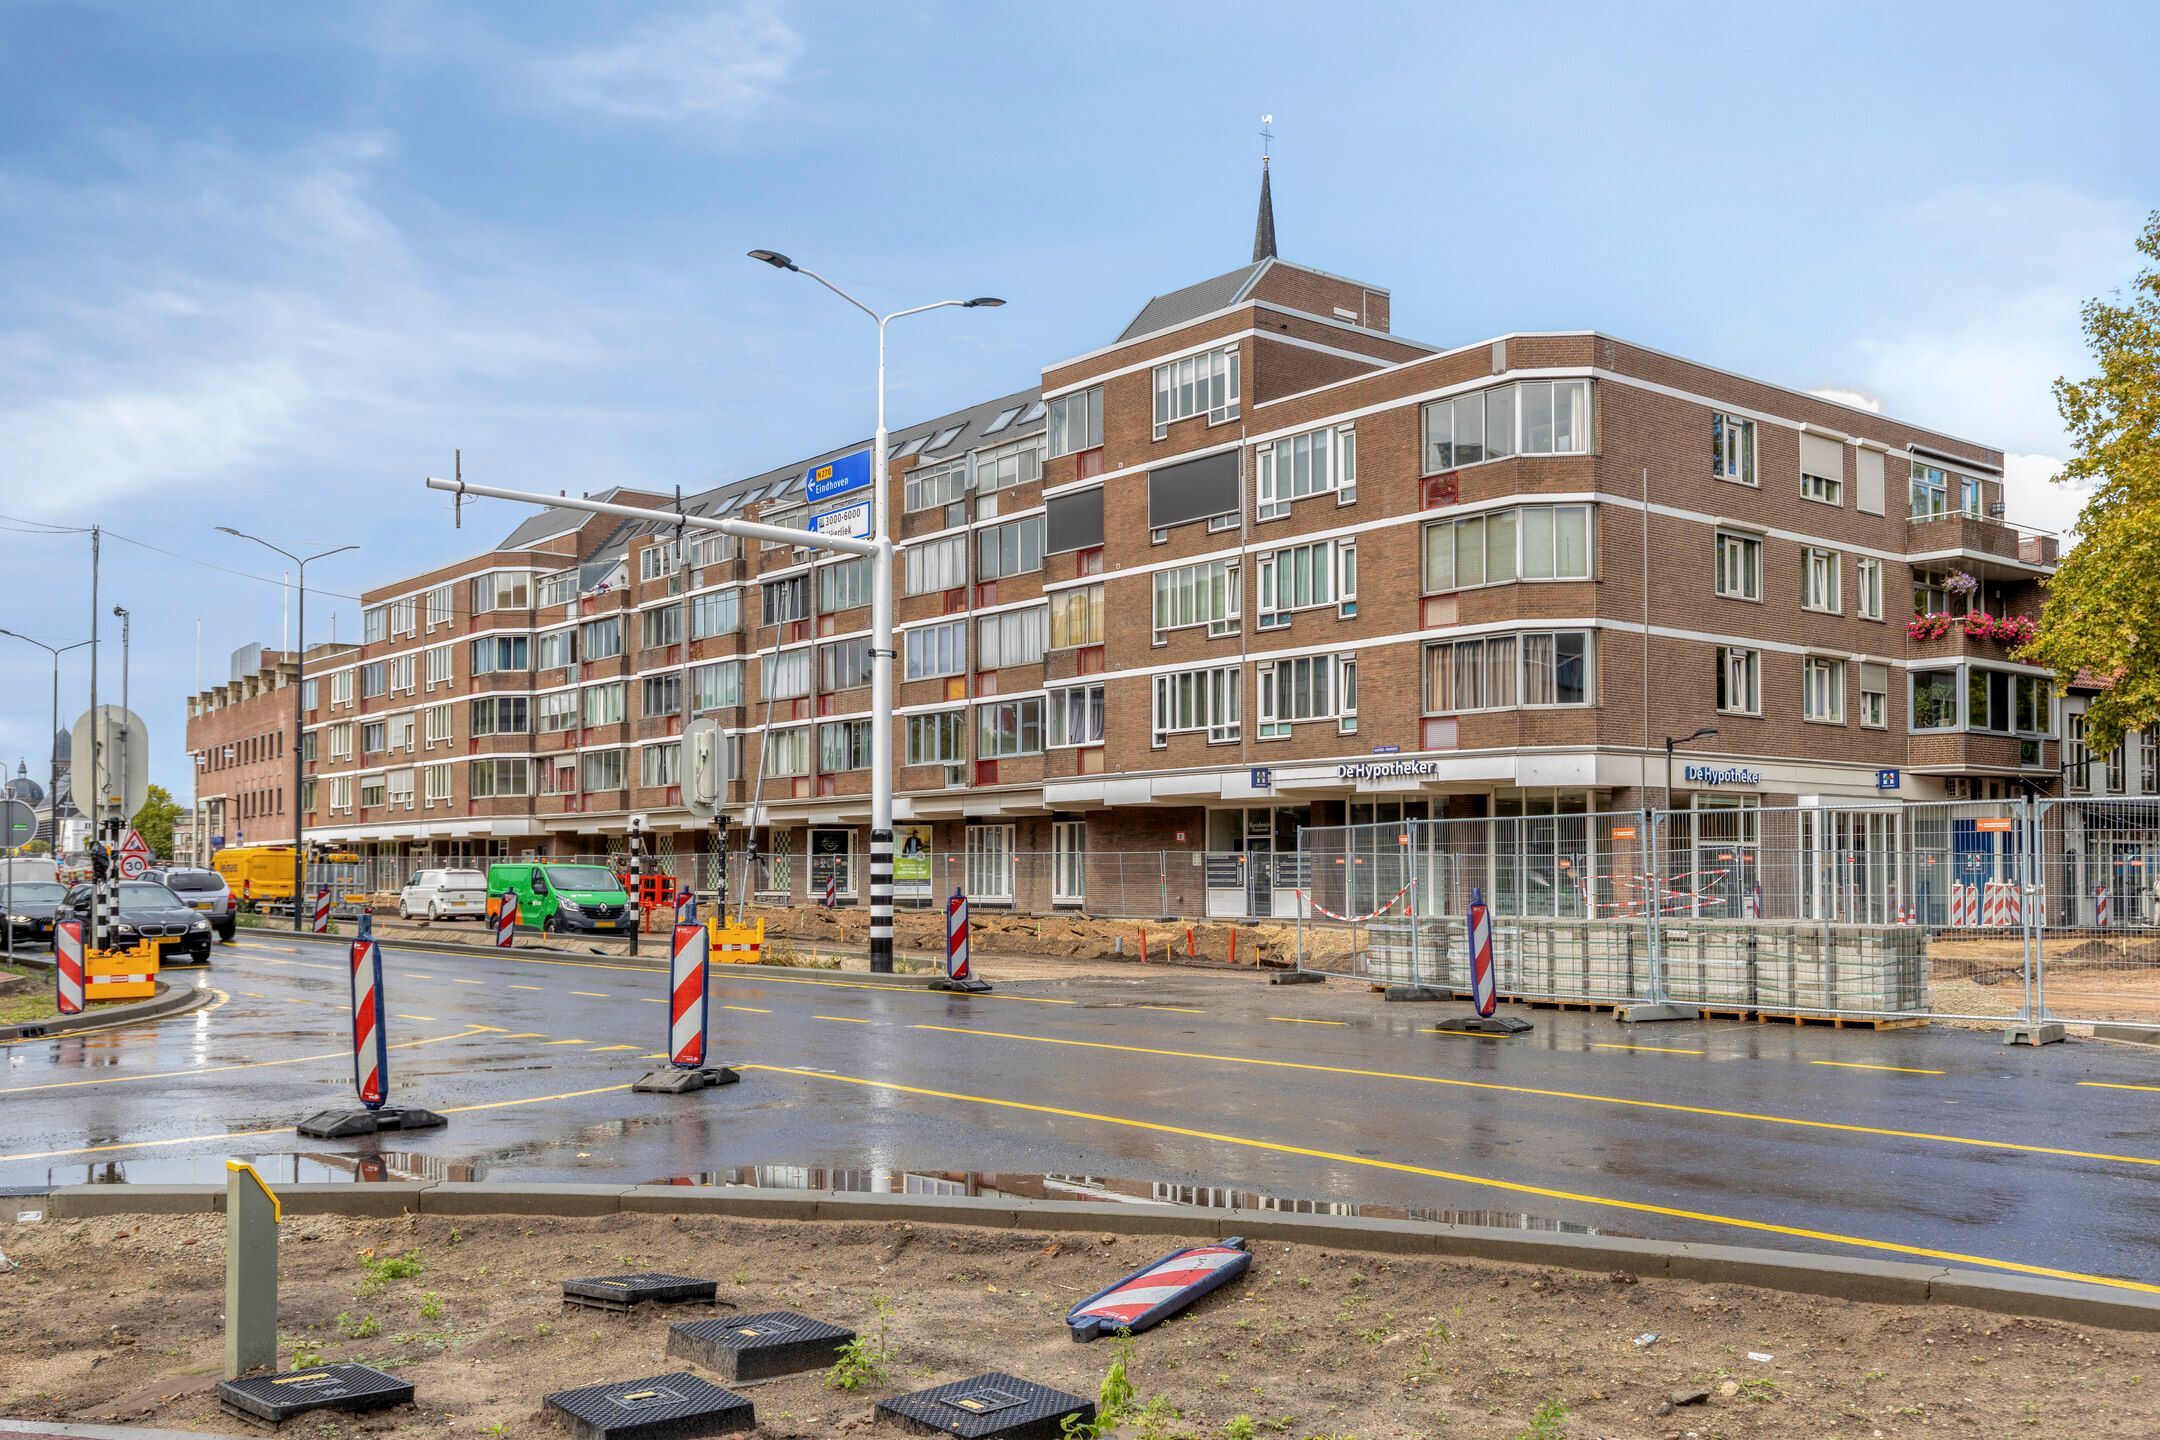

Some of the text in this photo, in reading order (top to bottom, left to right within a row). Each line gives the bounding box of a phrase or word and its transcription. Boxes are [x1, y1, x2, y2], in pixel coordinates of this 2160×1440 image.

[817, 468, 832, 478] N270
[816, 478, 848, 494] Eindhoven
[825, 508, 861, 526] 3000-6000
[1338, 759, 1434, 780] De Hypotheker
[1689, 765, 1761, 785] De Hypotheker
[125, 861, 142, 871] 30
